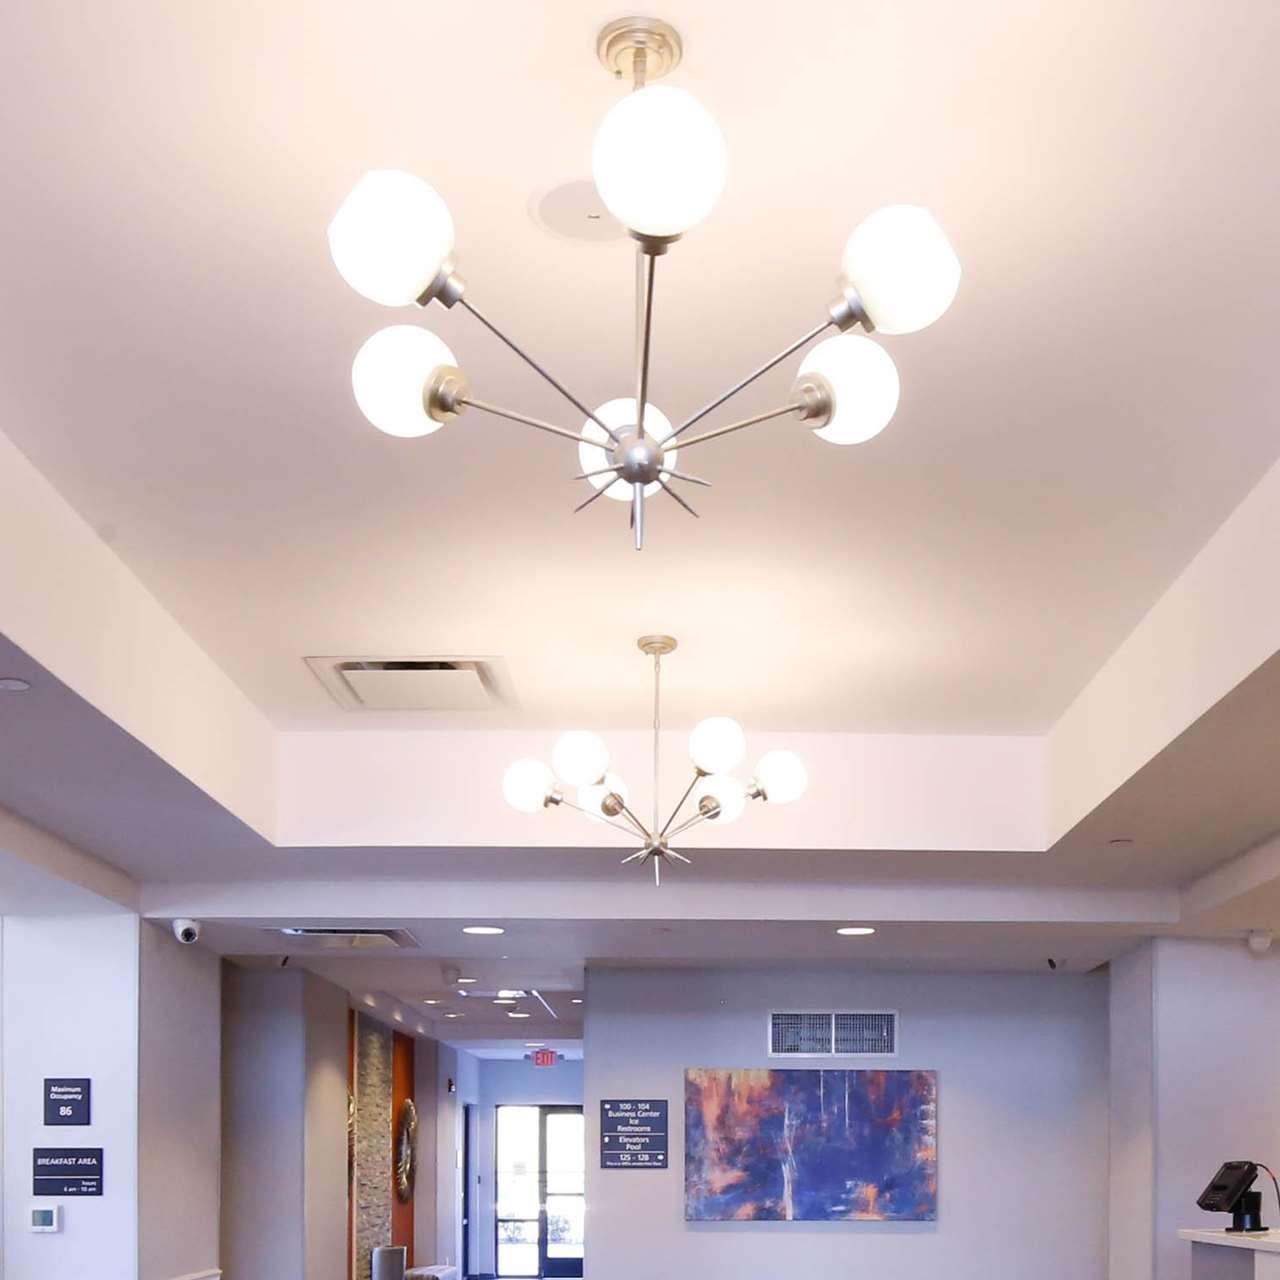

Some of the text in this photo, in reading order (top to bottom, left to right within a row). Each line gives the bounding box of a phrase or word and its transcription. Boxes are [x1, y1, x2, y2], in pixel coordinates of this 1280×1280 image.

[535, 1051, 554, 1065] EXIT
[59, 1106, 73, 1116] 86
[37, 1158, 97, 1166] BREAKFAST AREA
